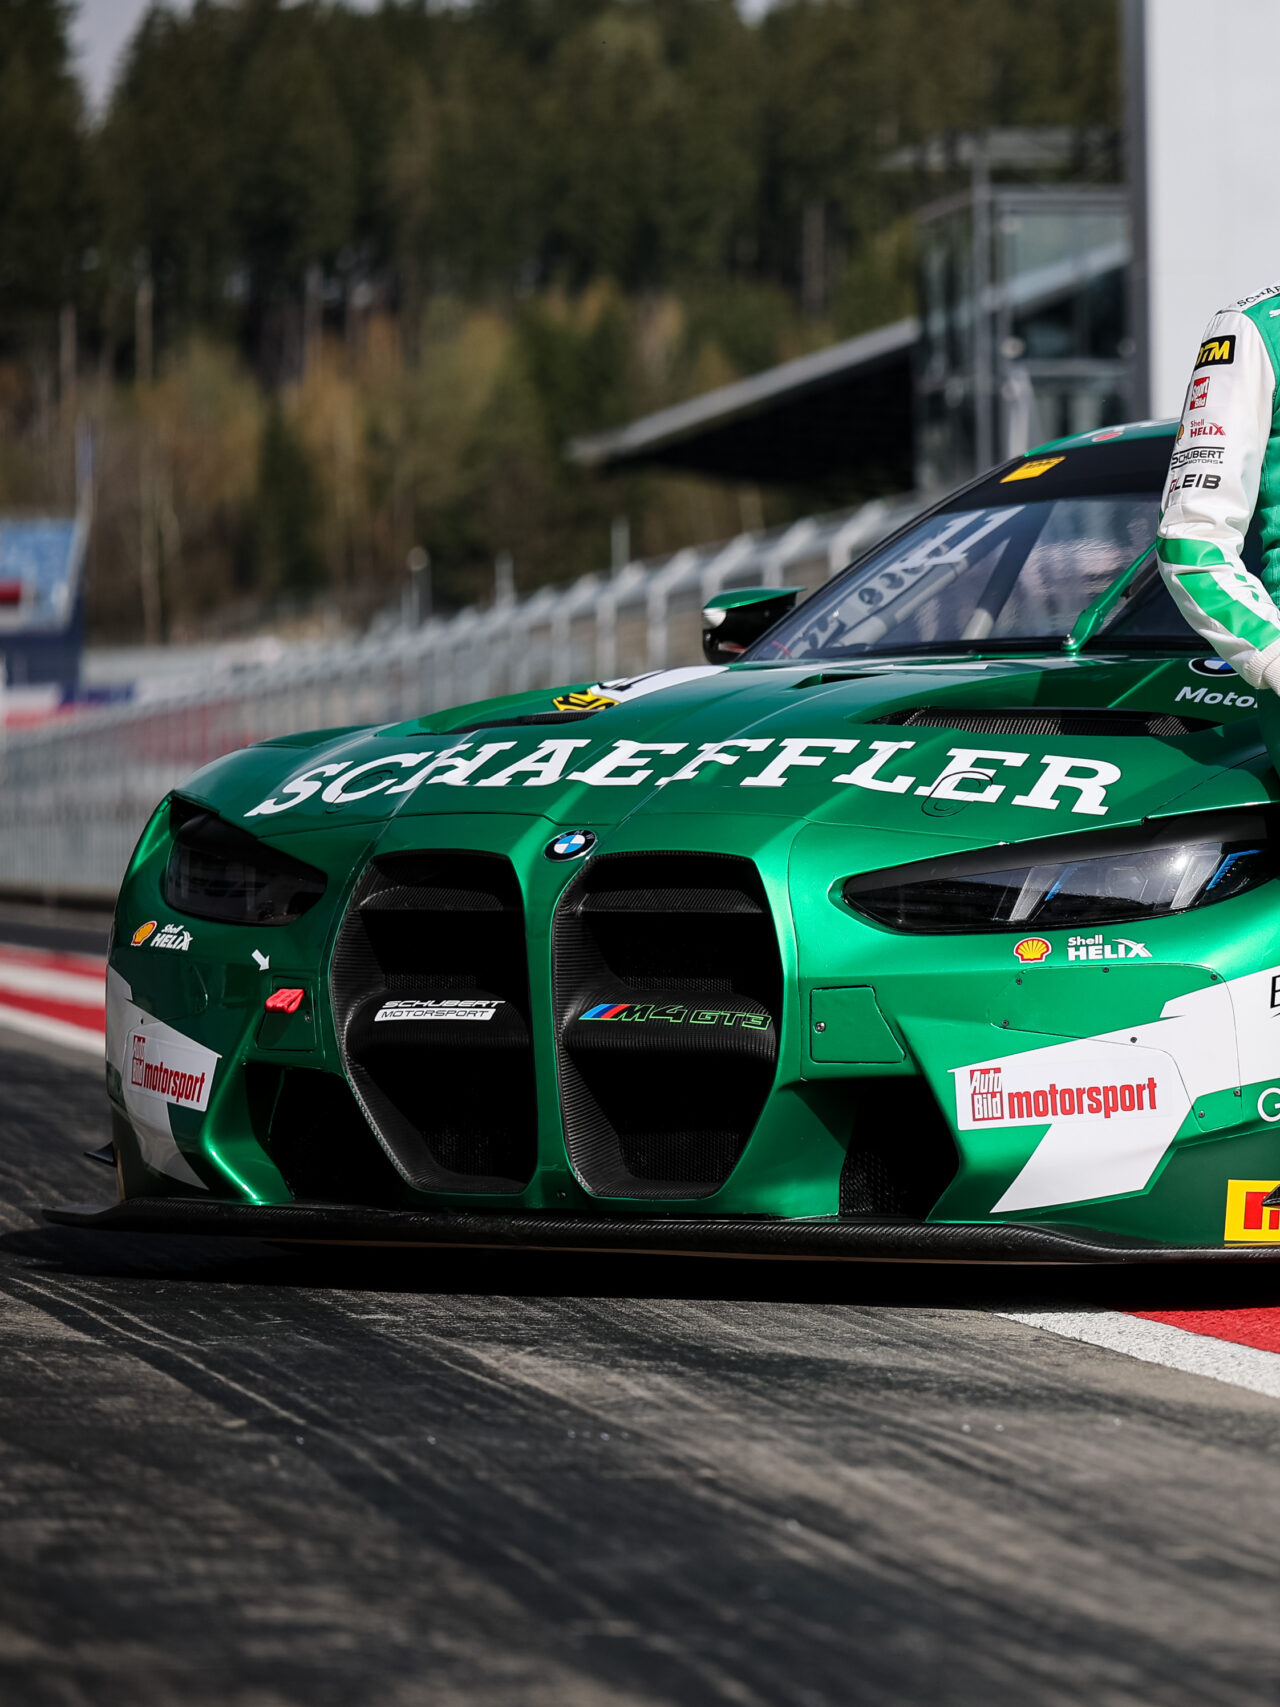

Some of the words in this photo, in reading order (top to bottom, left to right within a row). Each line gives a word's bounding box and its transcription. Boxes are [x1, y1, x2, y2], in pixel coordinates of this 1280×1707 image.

[1190, 422, 1226, 438] HELIX
[1170, 449, 1225, 466] SCHUBERT
[243, 738, 1122, 818] SCHAEFFLER
[161, 923, 185, 934] Shell
[151, 930, 194, 951] HELIX
[1067, 935, 1104, 946] Shell
[1067, 939, 1153, 962] HELIX
[380, 1008, 491, 1019] MOTORSPORT
[381, 1000, 506, 1009] SCHUBERT
[688, 1009, 772, 1031] GT3
[144, 1061, 206, 1103] motorsport
[971, 1070, 1002, 1094] Auto
[973, 1093, 1002, 1120] Bild
[1007, 1077, 1158, 1119] motorsport
